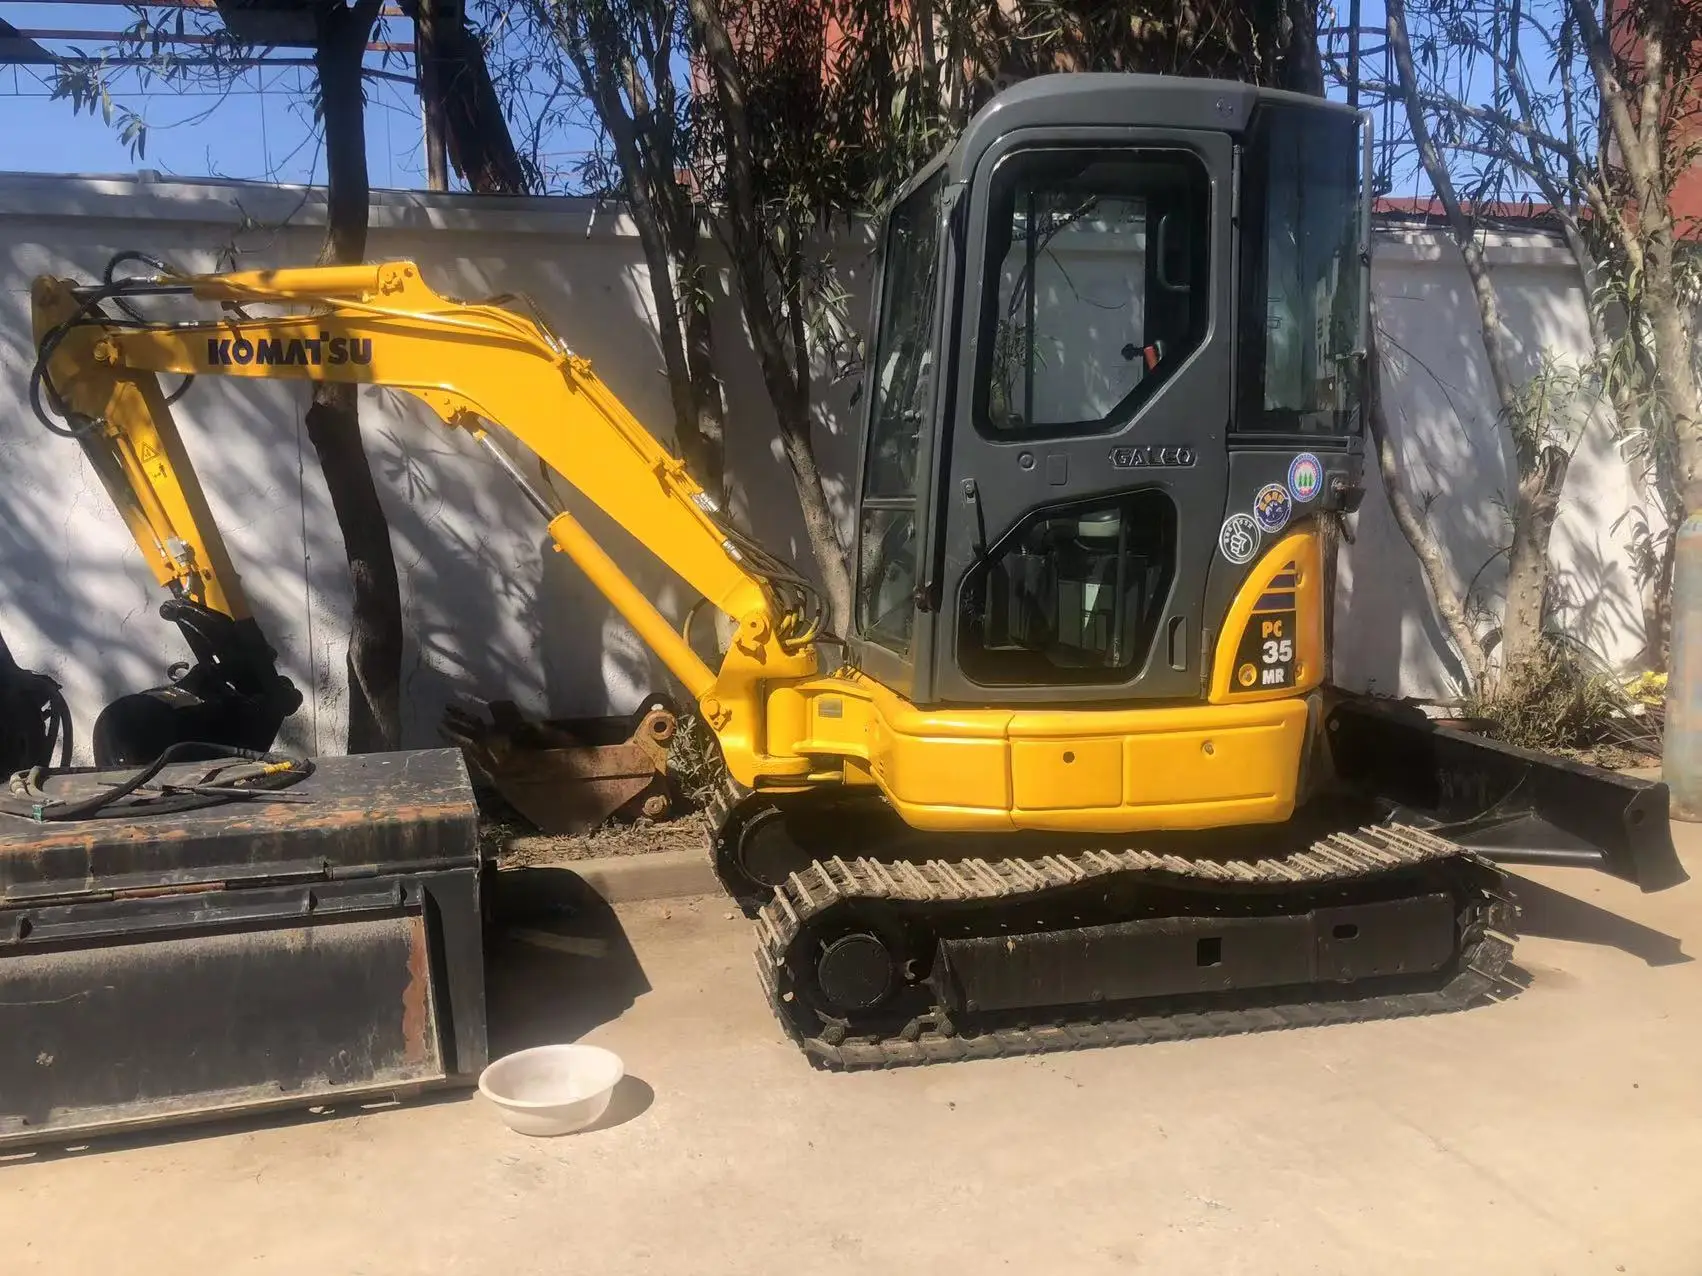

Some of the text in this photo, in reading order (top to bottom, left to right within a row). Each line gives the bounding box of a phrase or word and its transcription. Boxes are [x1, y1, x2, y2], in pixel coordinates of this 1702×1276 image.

[208, 332, 372, 365] KOMATSU
[1262, 620, 1283, 639] PC
[1262, 640, 1293, 664] 35
[1262, 668, 1285, 685] MR
